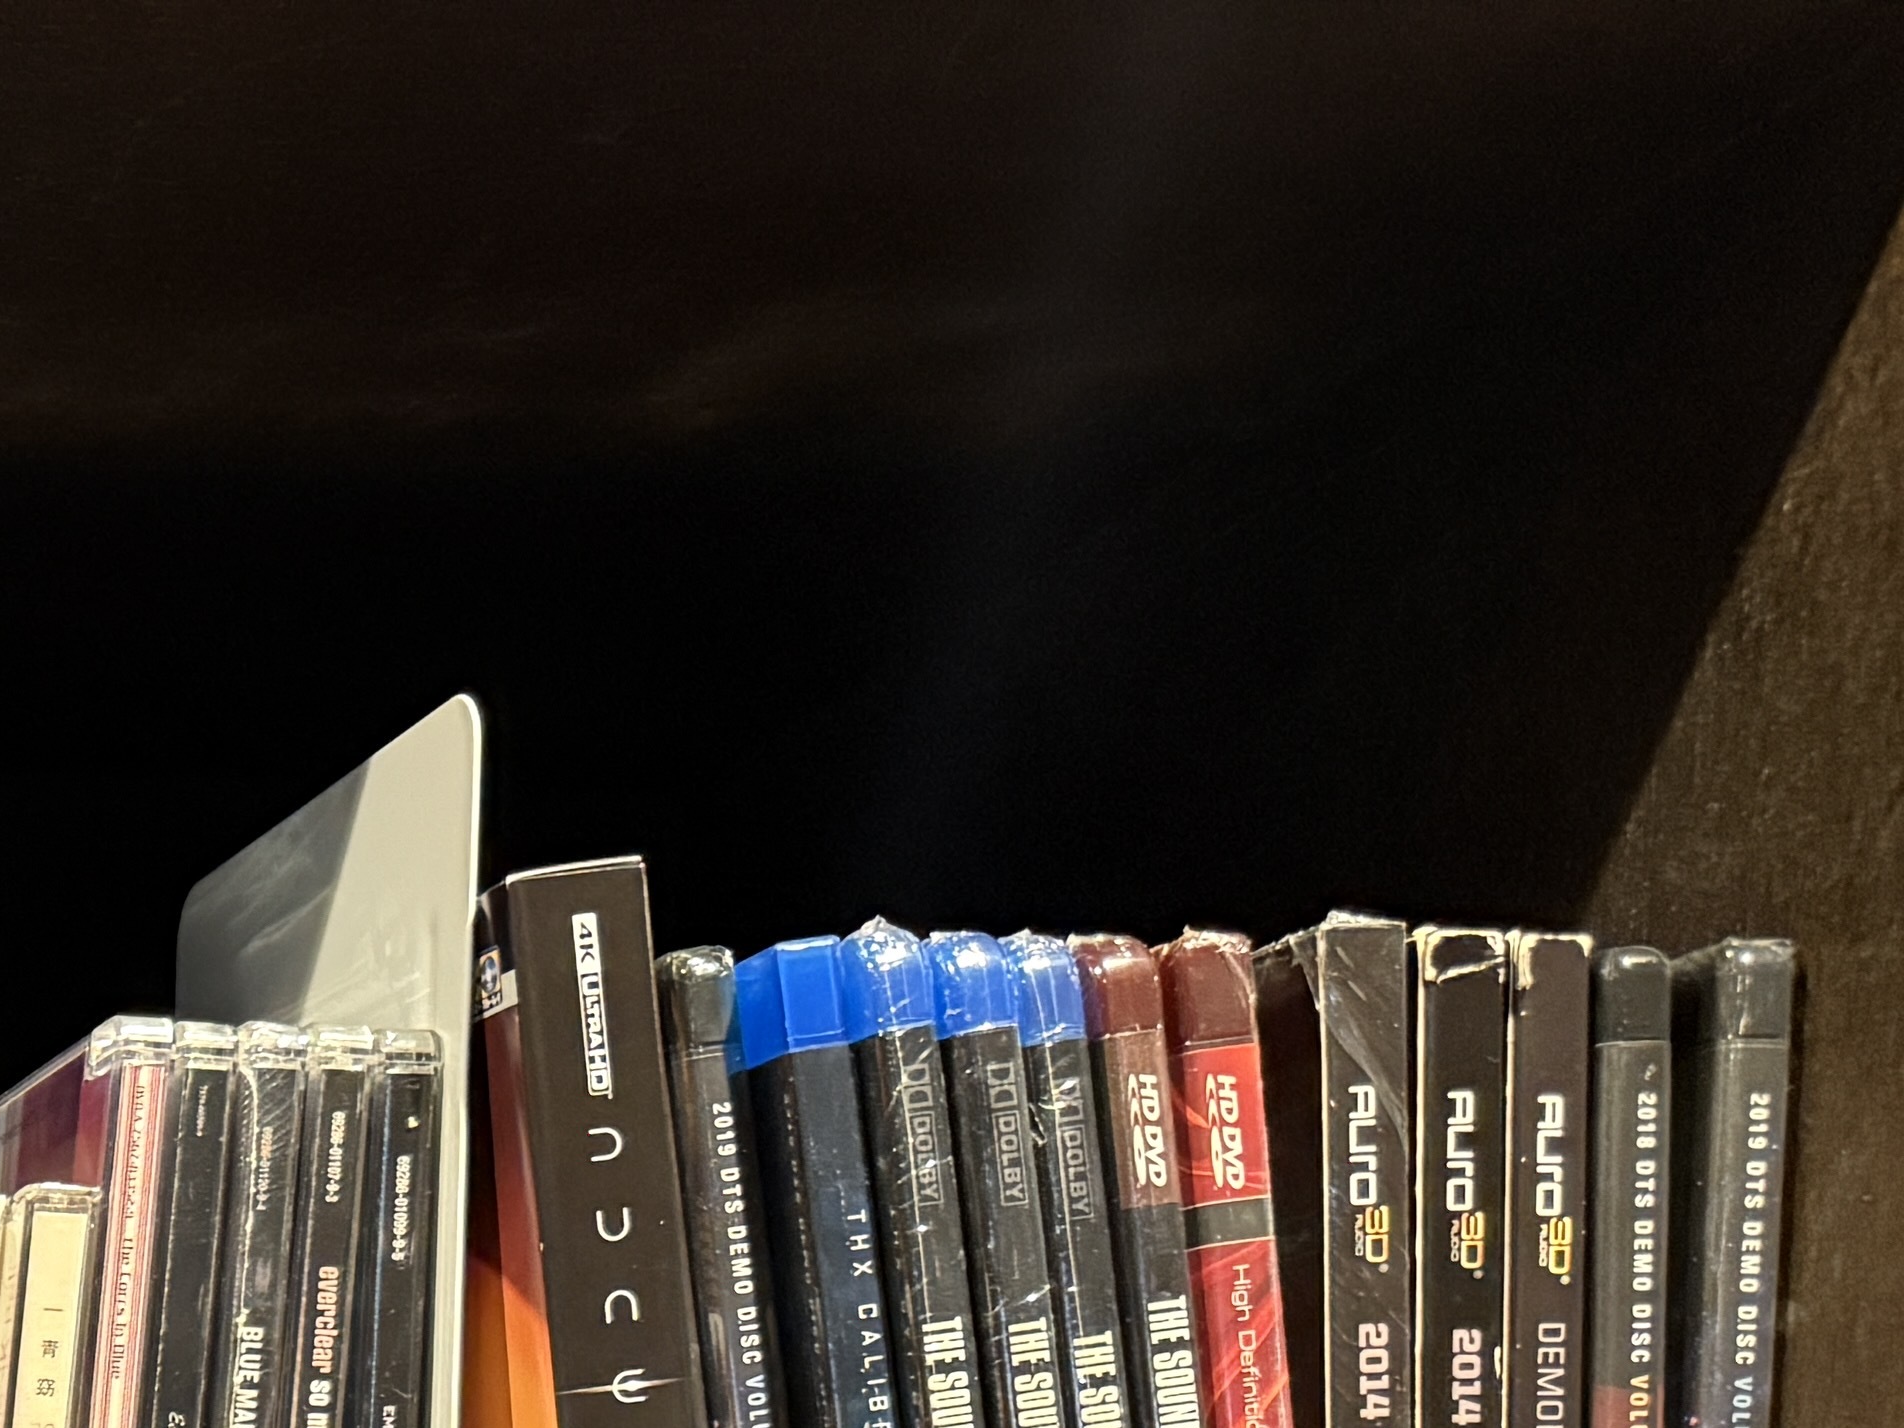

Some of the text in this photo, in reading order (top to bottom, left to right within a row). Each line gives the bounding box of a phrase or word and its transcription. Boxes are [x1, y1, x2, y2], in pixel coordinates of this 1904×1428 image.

[711, 1100, 737, 1158] 2019
[719, 1168, 741, 1213] DTS
[726, 1222, 752, 1296] DEMO
[235, 1325, 265, 1384] BLUE
[735, 1304, 762, 1364] DISC
[922, 1316, 964, 1364] THE
